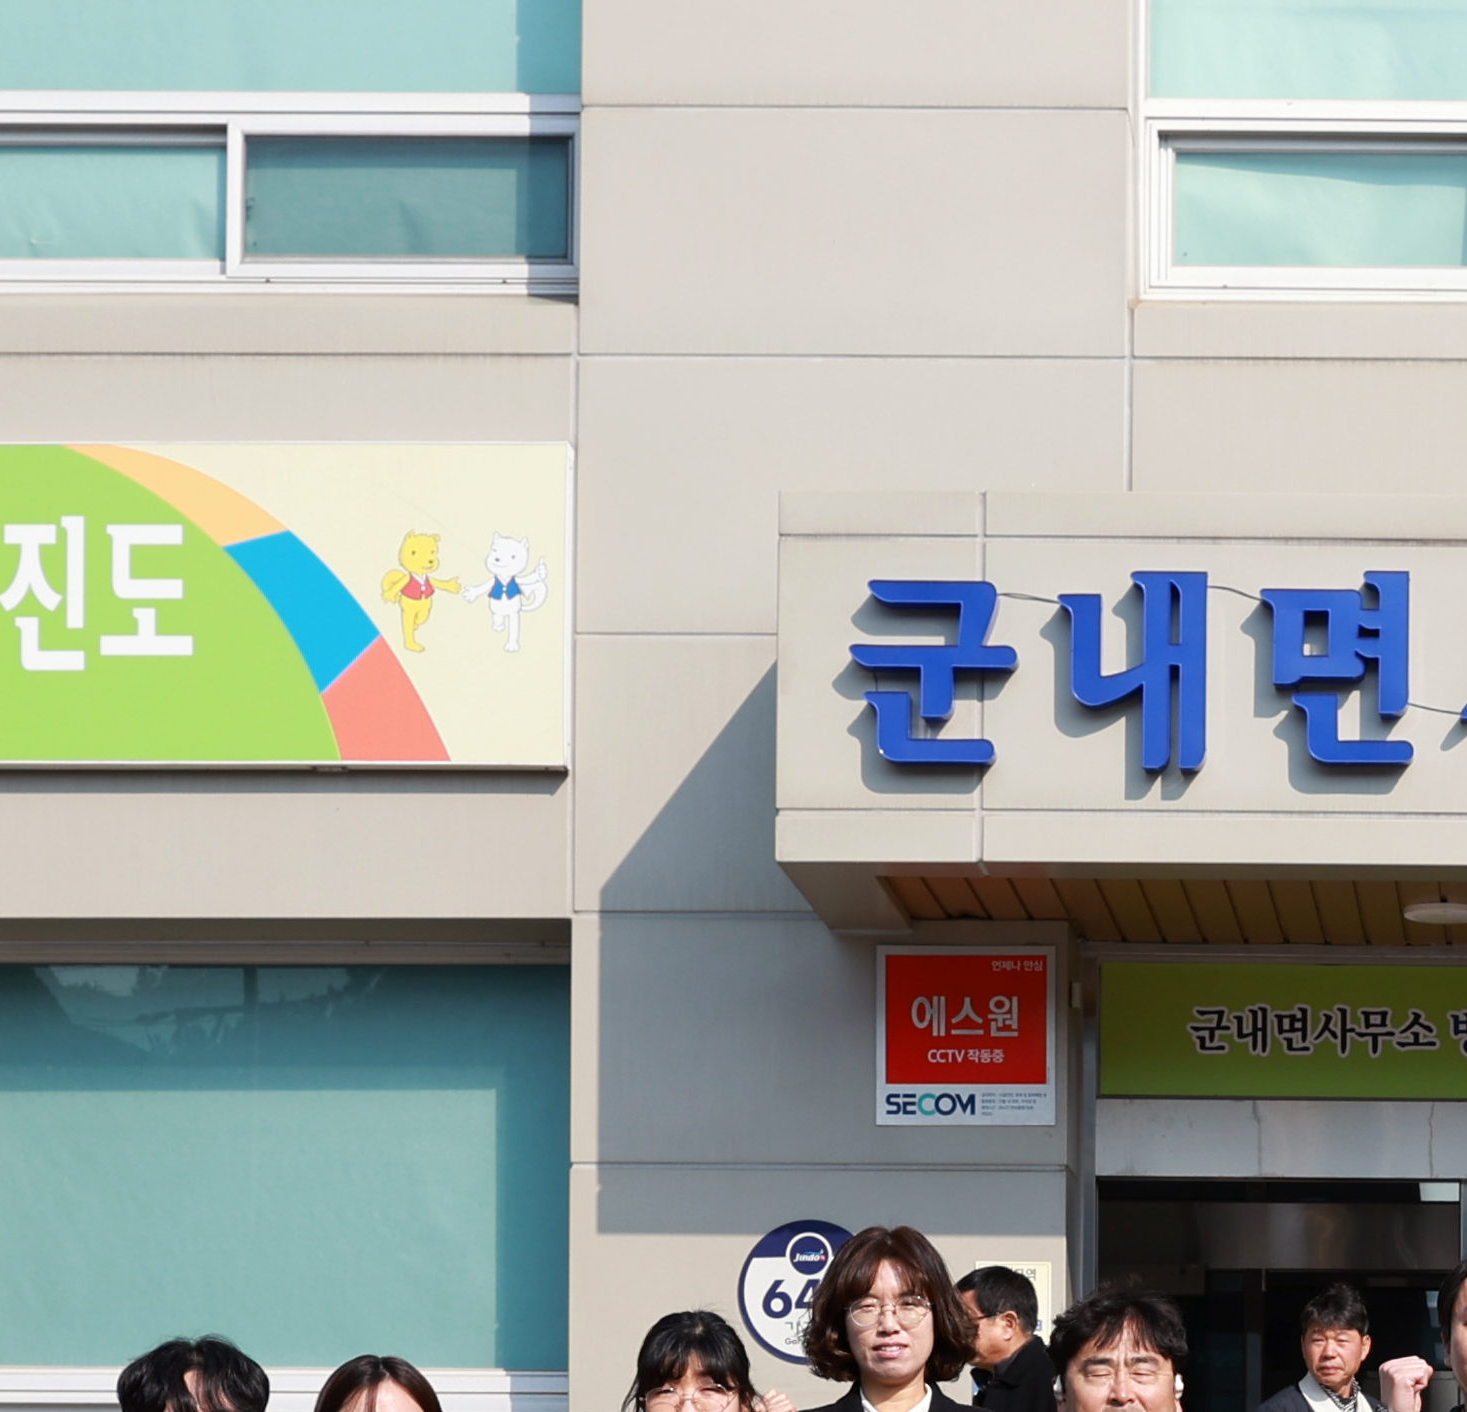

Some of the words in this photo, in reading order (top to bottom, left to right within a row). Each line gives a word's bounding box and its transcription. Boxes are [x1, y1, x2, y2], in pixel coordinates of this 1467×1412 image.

[911, 995, 1019, 1037] 에스원
[1189, 1006, 1438, 1056] 군내면사무소
[927, 1049, 965, 1063] CCTV
[885, 1092, 976, 1116] SECOM
